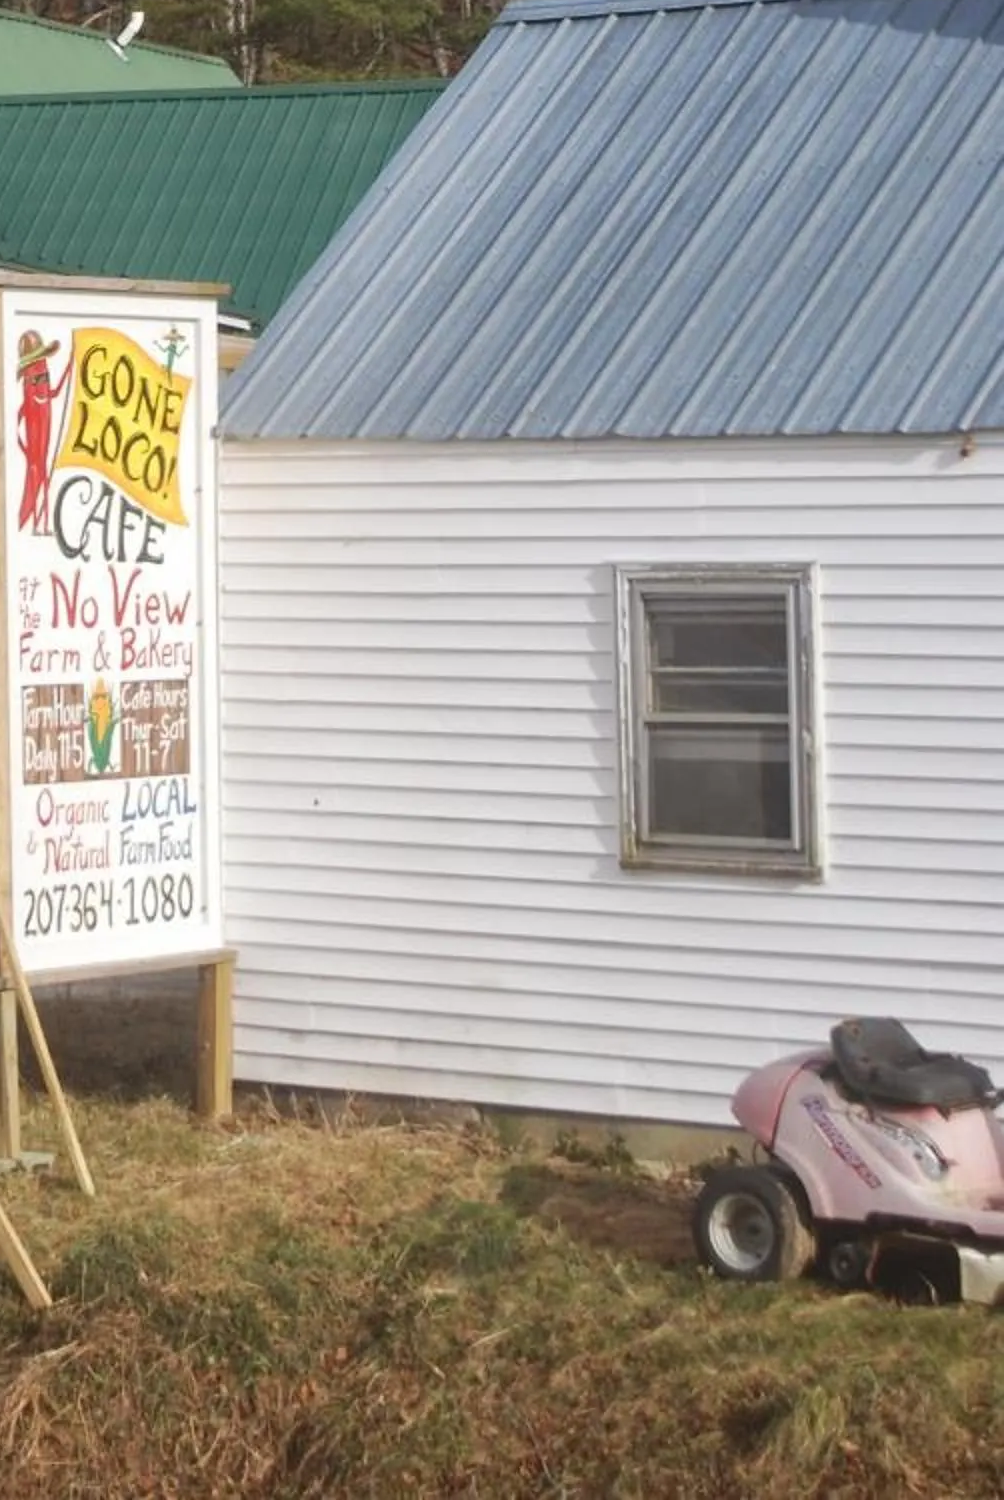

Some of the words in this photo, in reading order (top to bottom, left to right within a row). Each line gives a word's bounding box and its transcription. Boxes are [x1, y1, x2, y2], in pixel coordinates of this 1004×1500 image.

[81, 343, 183, 434] GONE
[72, 402, 177, 499] LOCO!
[53, 474, 166, 564] CAFE
[50, 567, 99, 629] No
[108, 564, 191, 627] View
[19, 631, 81, 672] Farm
[93, 630, 111, 672] &
[153, 681, 187, 708] Hours
[25, 733, 57, 781] Daily
[36, 787, 110, 841] Organic
[121, 777, 197, 823] LOCAL
[43, 829, 110, 875] Natural
